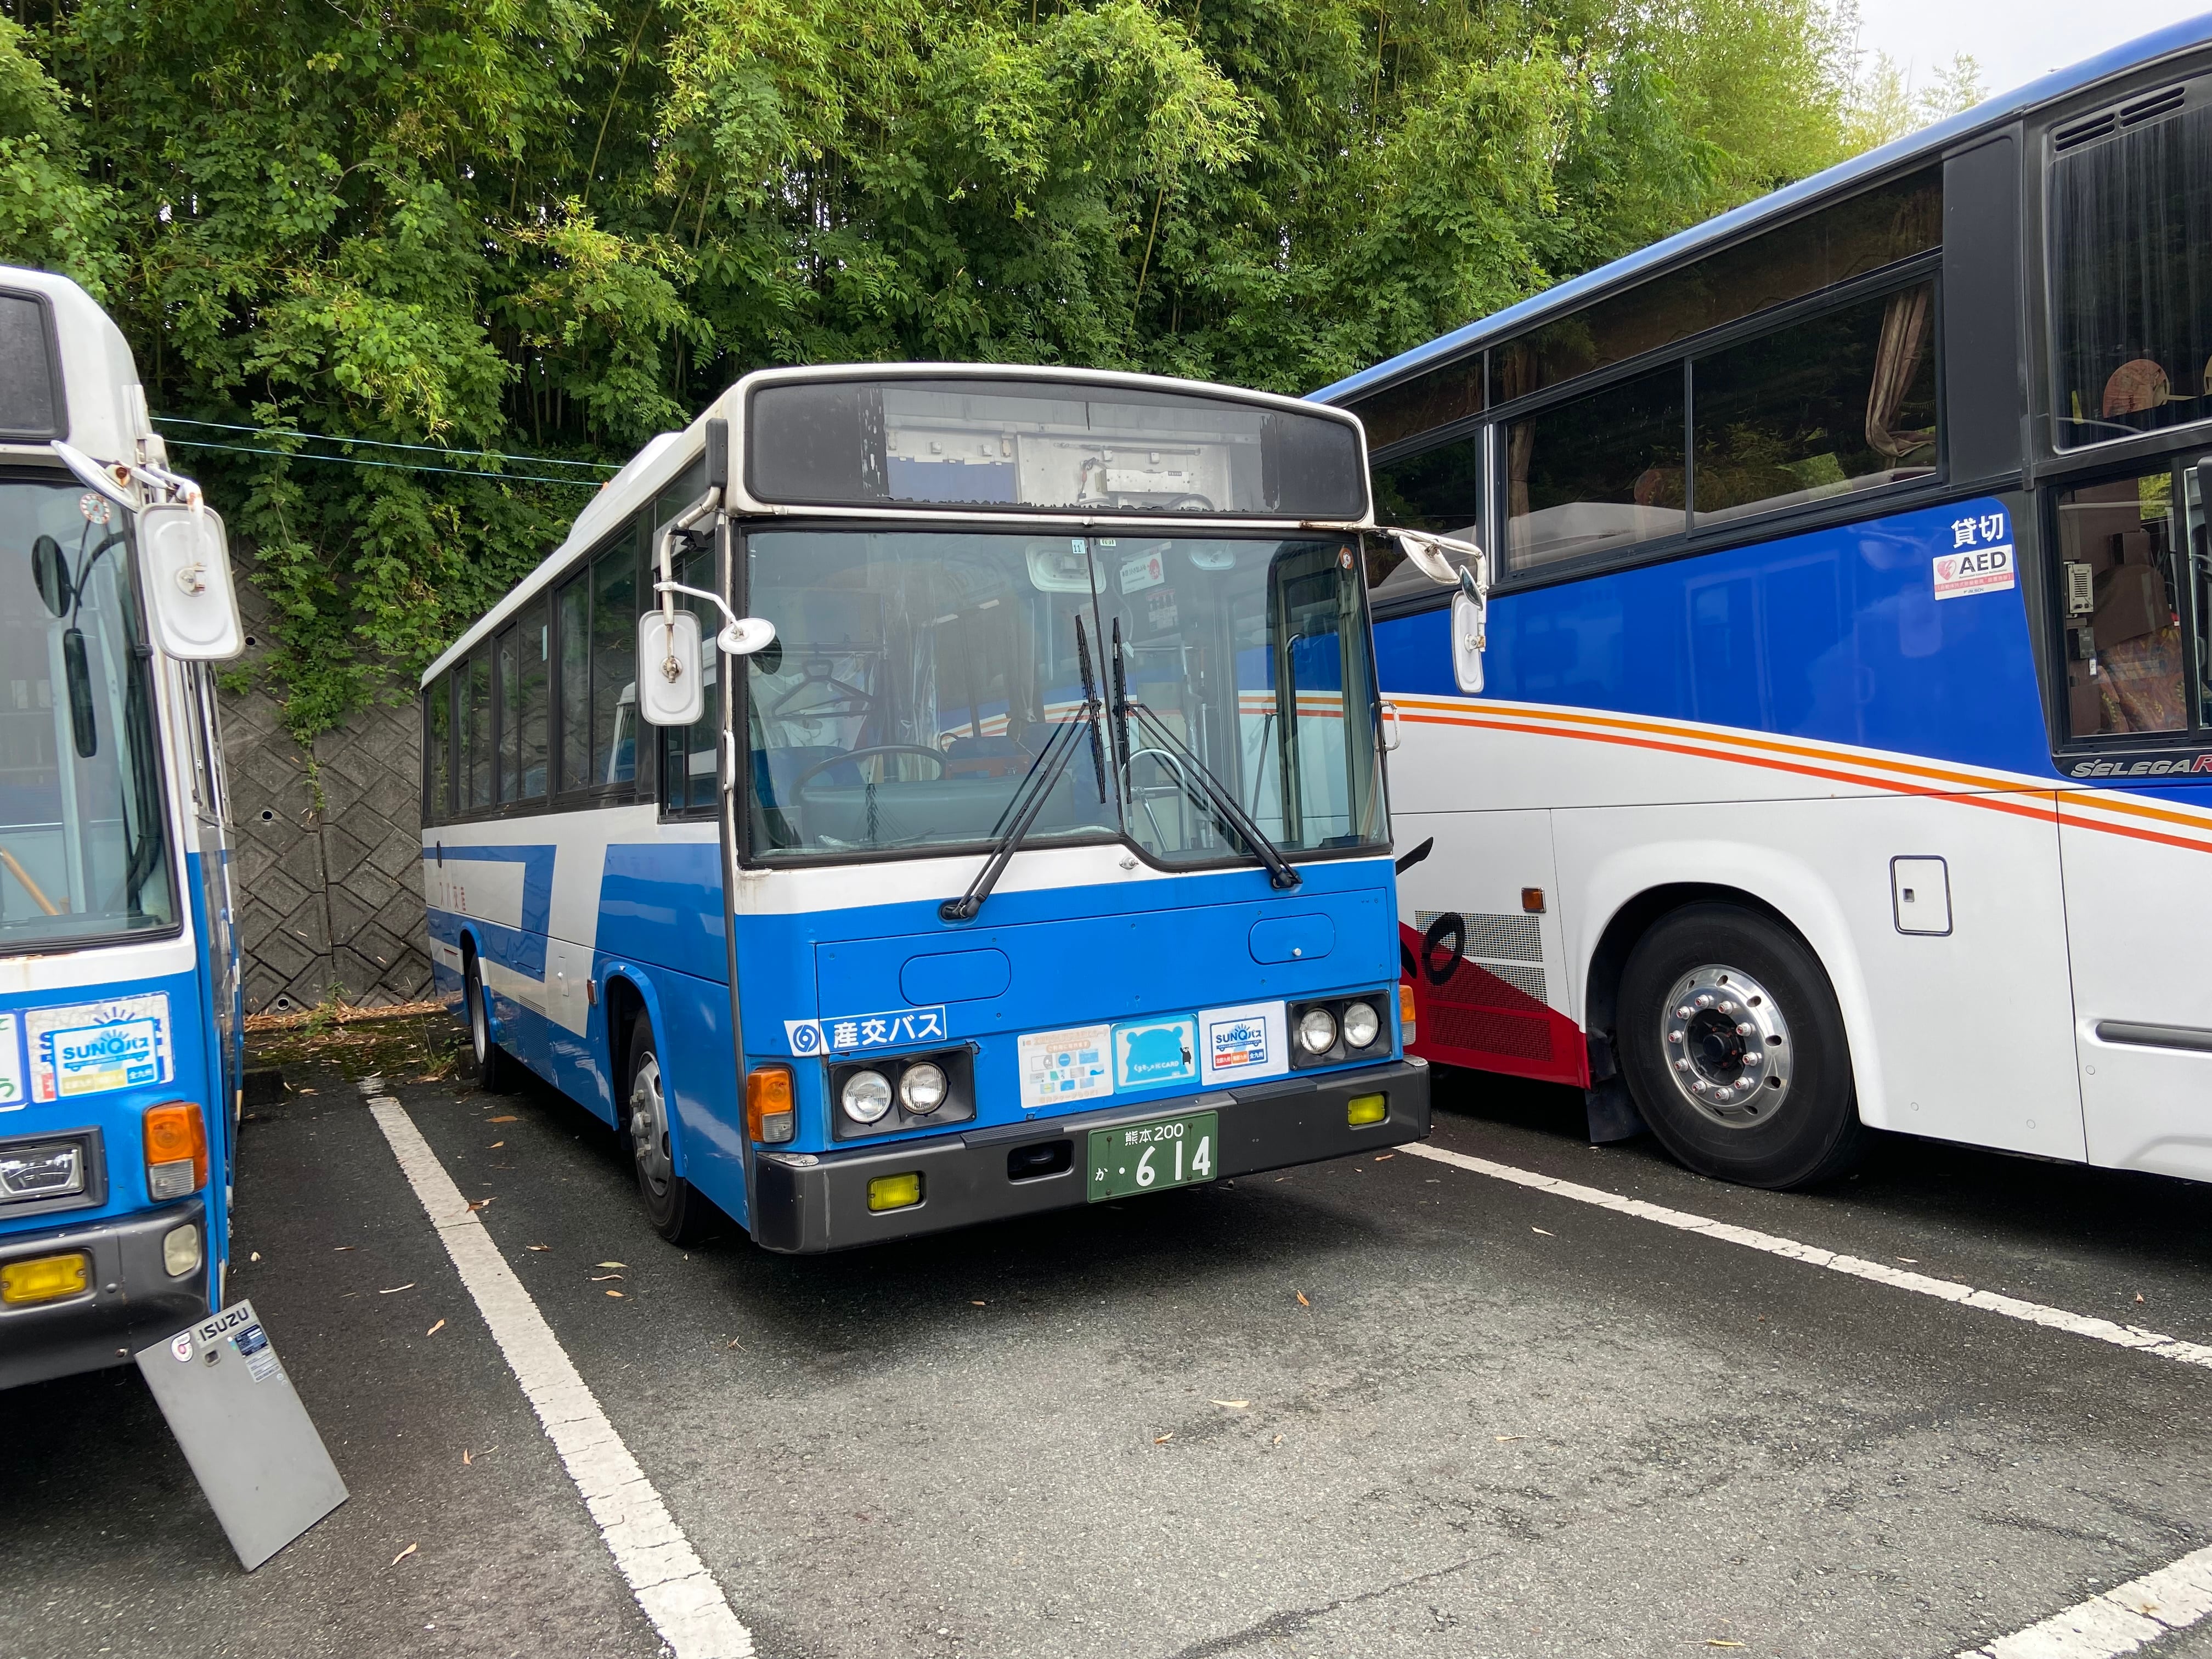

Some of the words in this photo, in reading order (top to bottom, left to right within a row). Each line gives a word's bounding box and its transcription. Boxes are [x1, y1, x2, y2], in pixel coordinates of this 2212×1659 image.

[1951, 513, 2004, 549] 貸切
[1959, 551, 2007, 575] AED
[833, 1013, 943, 1049] 産交バス
[199, 1307, 249, 1341] ISUZU
